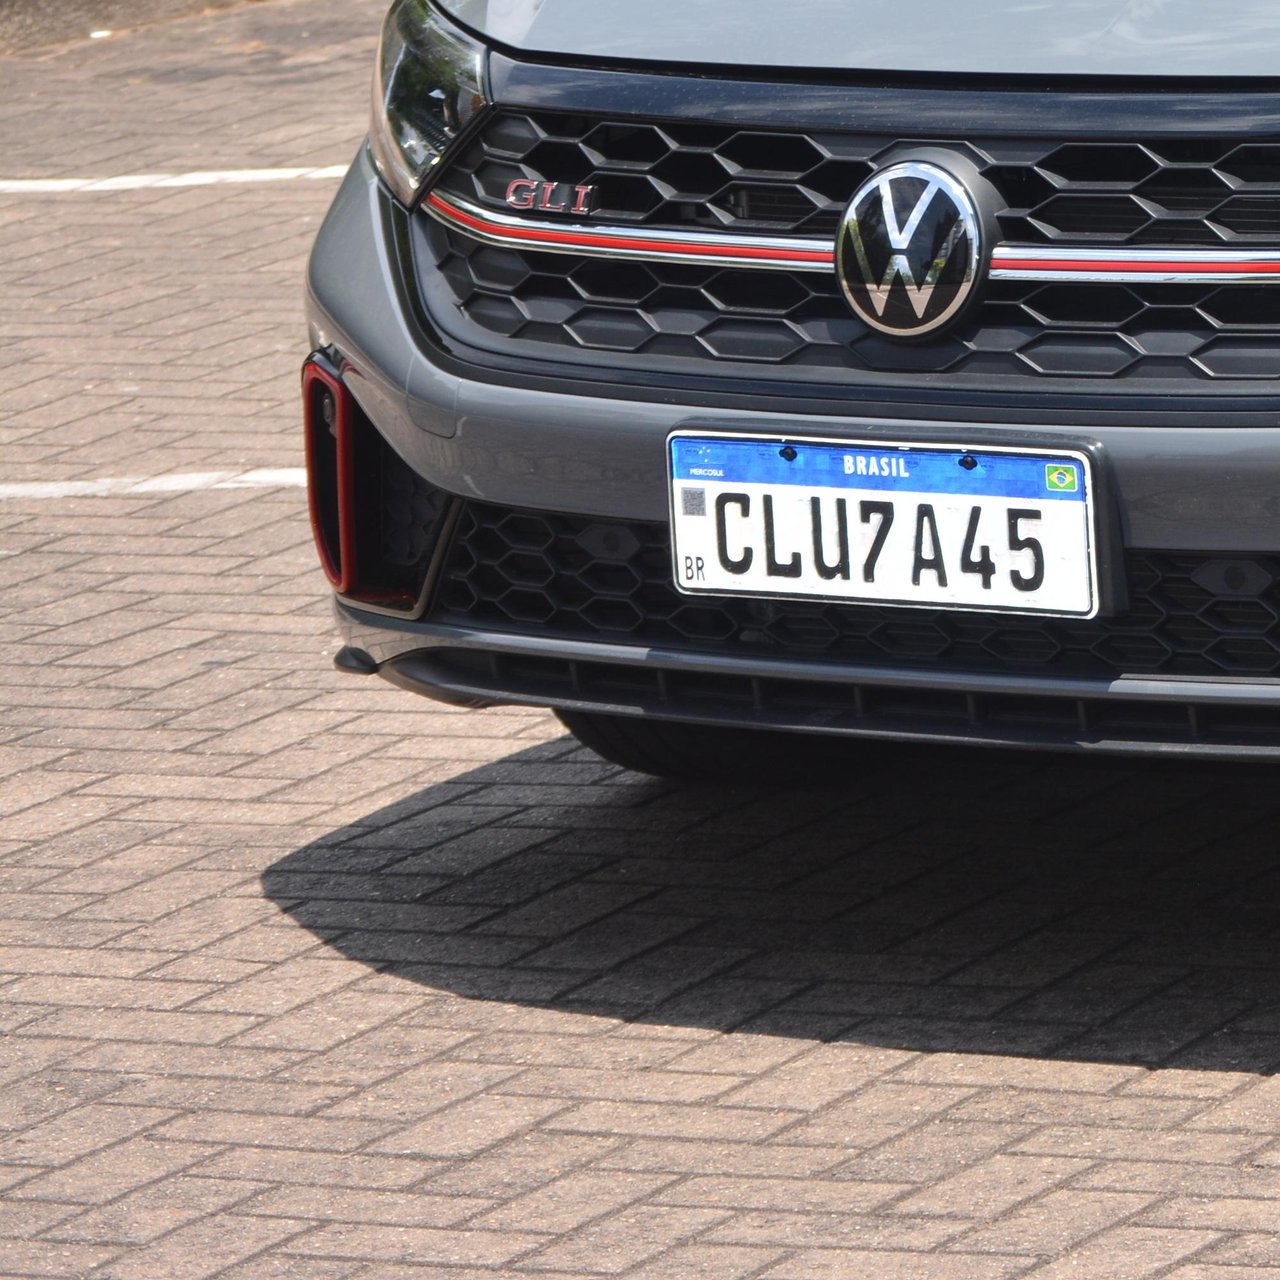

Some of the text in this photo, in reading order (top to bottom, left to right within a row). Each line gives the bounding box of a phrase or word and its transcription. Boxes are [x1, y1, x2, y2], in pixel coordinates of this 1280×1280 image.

[505, 178, 594, 216] GLI
[688, 467, 725, 478] MERCOSUL
[842, 455, 910, 478] BRASIL
[714, 492, 1045, 593] CLU7A45
[684, 555, 706, 582] BR
